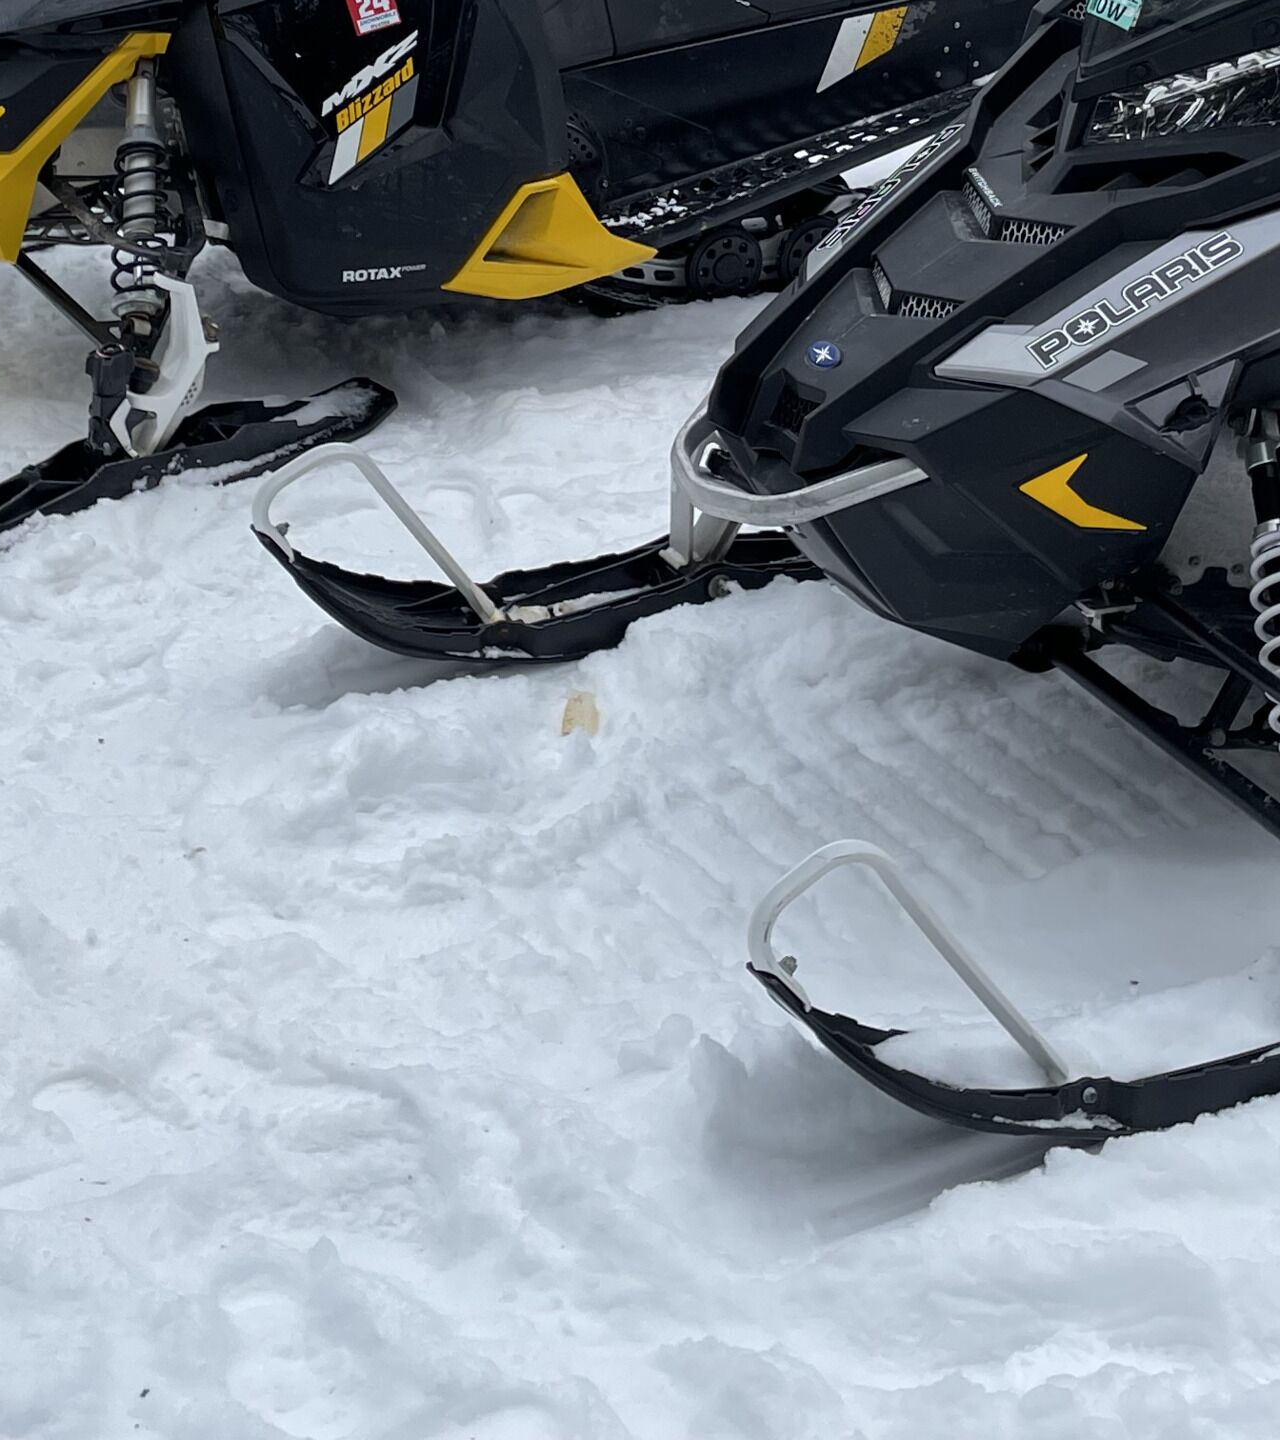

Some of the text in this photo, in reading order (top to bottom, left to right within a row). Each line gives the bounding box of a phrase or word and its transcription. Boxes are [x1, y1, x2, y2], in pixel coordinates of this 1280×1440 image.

[335, 56, 415, 134] Blizzard
[342, 267, 402, 282] ROTAX
[1025, 231, 1245, 370] POLARIS
